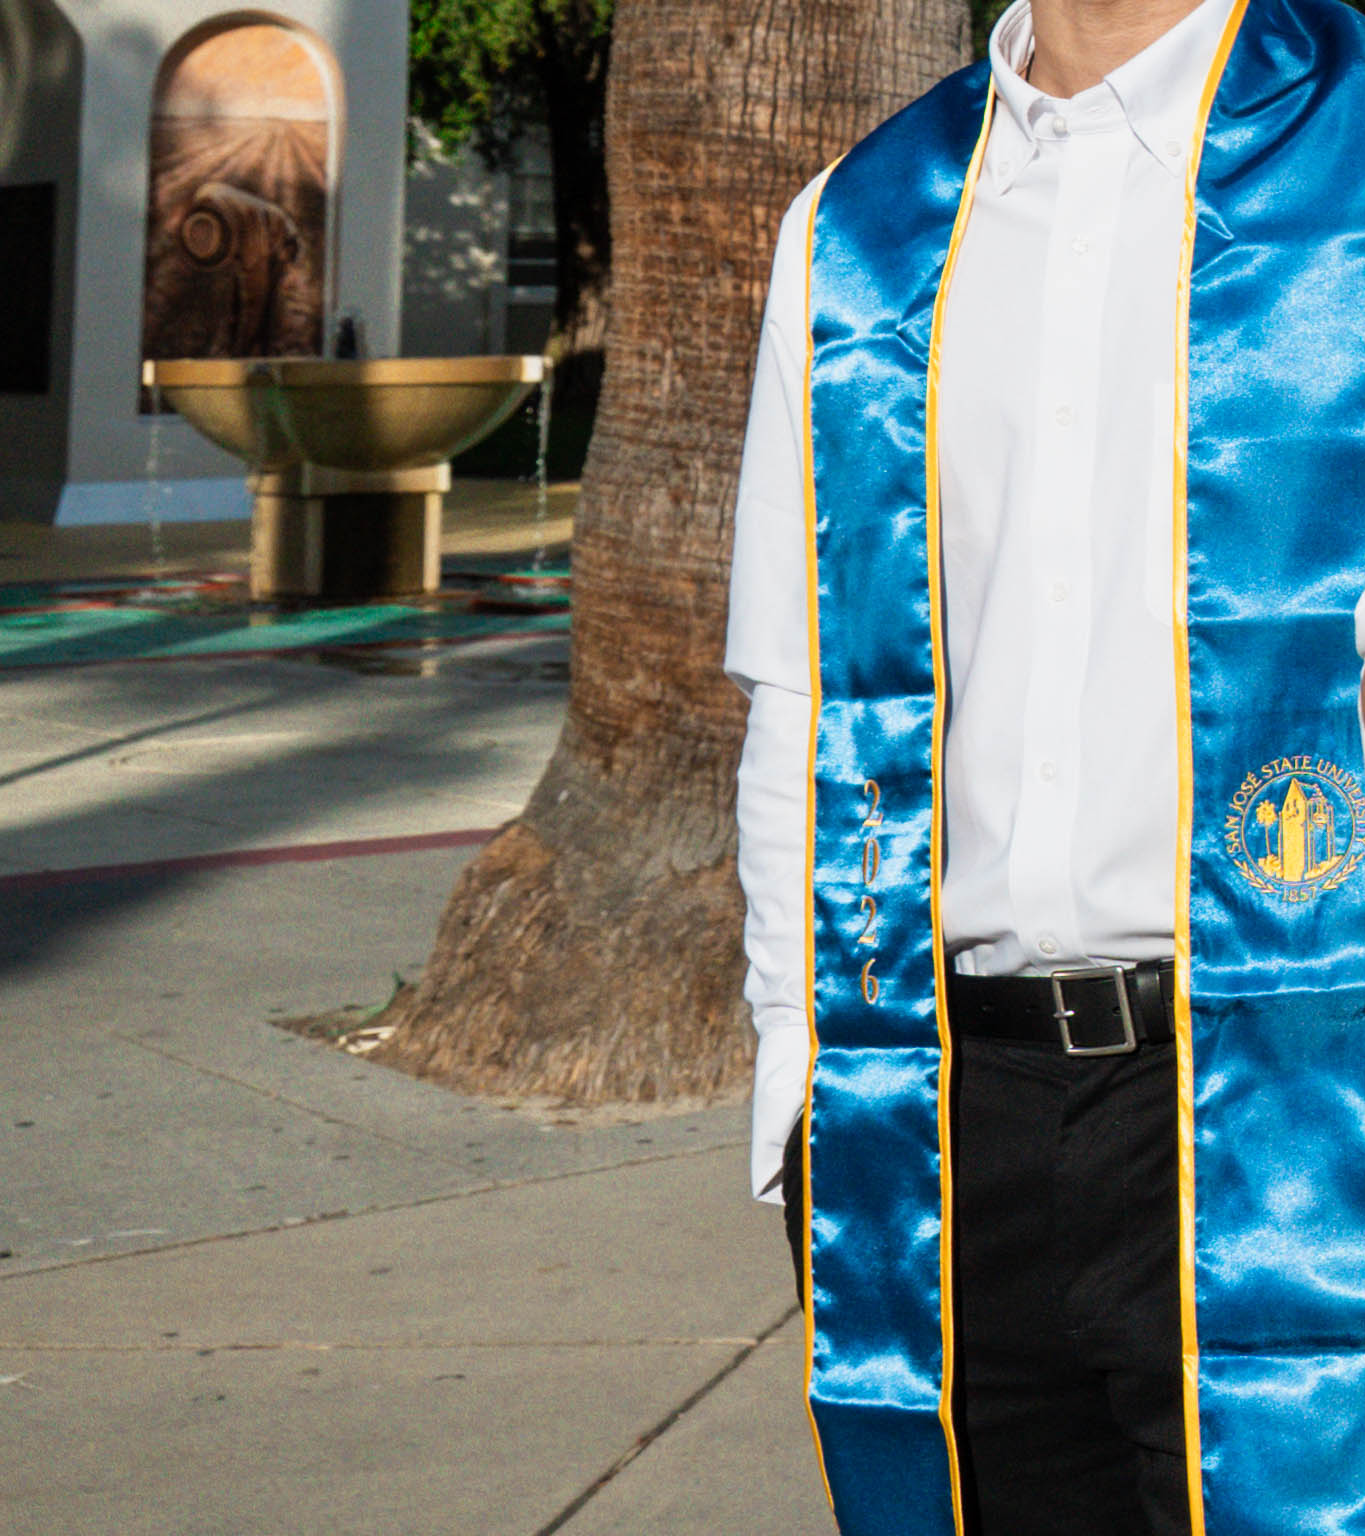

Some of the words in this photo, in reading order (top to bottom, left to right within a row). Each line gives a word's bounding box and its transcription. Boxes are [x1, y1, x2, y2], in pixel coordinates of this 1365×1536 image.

[1224, 815, 1242, 855] SAN
[1261, 755, 1313, 780] STATE
[857, 779, 883, 1005] 2026
[1282, 887, 1317, 903] 1857
